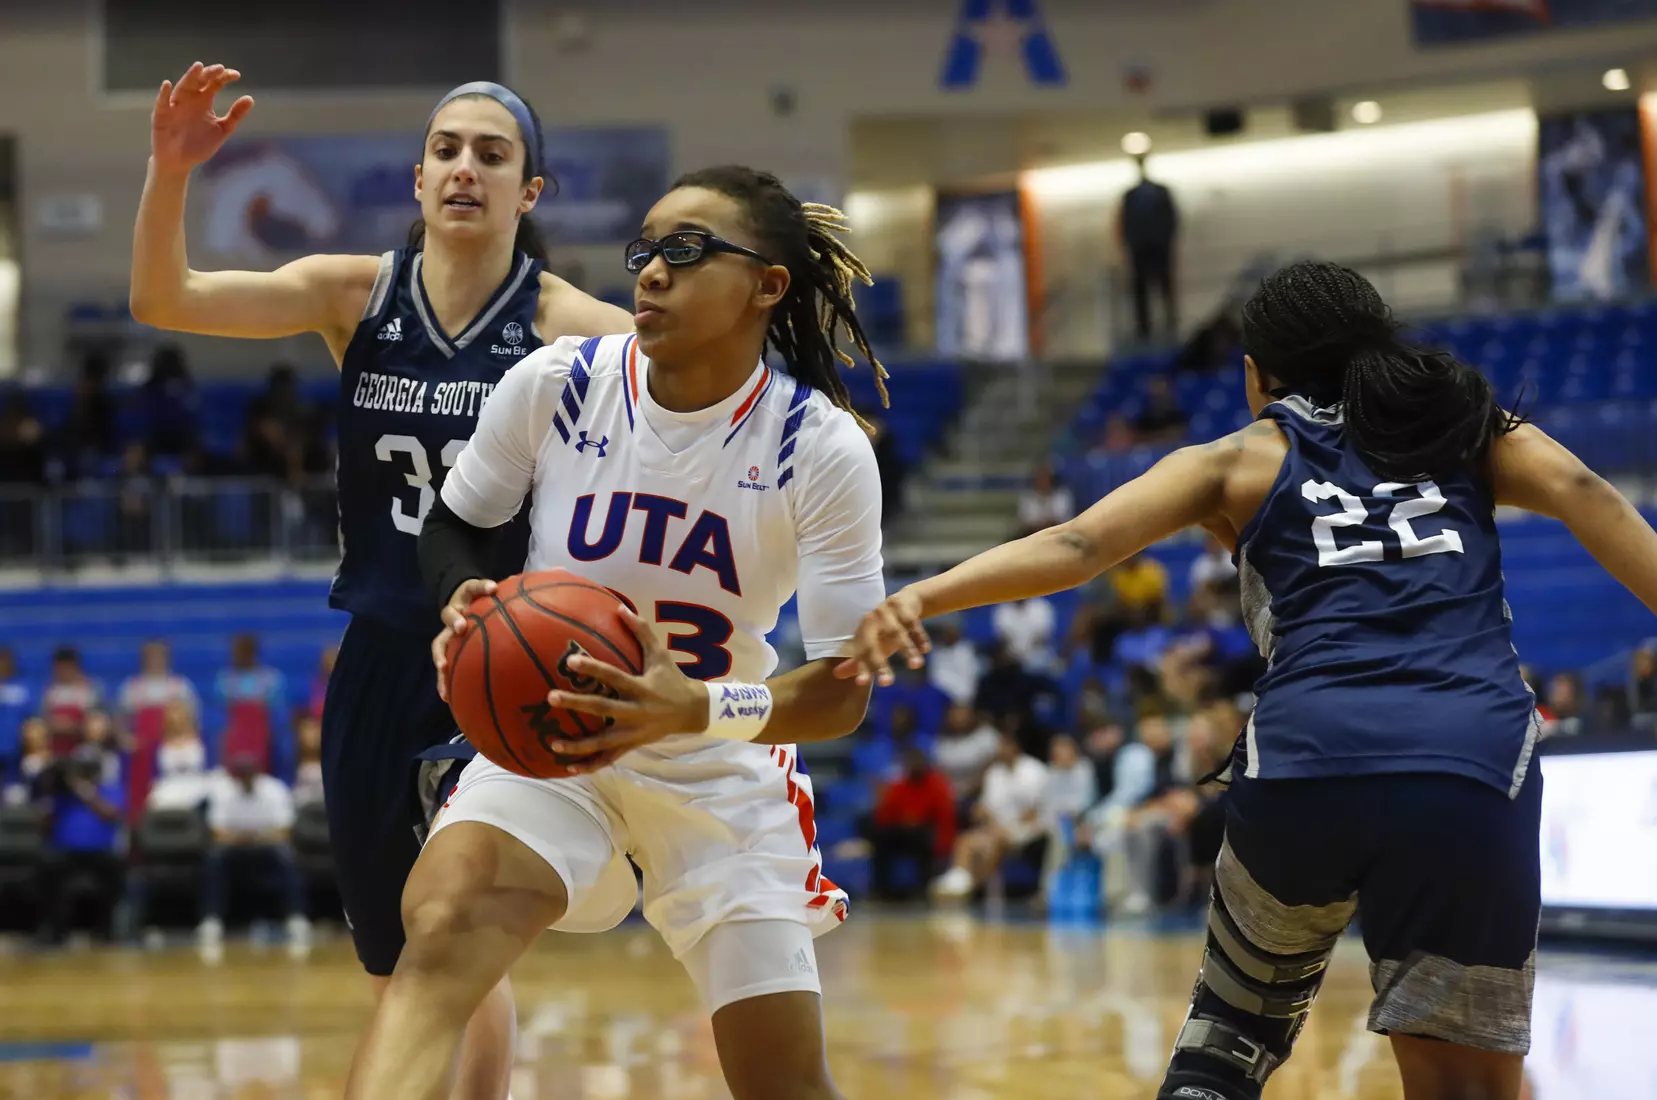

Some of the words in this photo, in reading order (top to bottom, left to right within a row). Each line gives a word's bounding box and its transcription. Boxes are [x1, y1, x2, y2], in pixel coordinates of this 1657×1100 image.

[377, 332, 403, 341] adidas
[513, 345, 527, 356] BE
[353, 371, 428, 414] GEORGIA
[430, 380, 495, 418] SOUTH
[374, 434, 470, 536] 3
[1301, 478, 1464, 568] 22
[567, 491, 742, 598] UTA
[604, 586, 734, 682] 3
